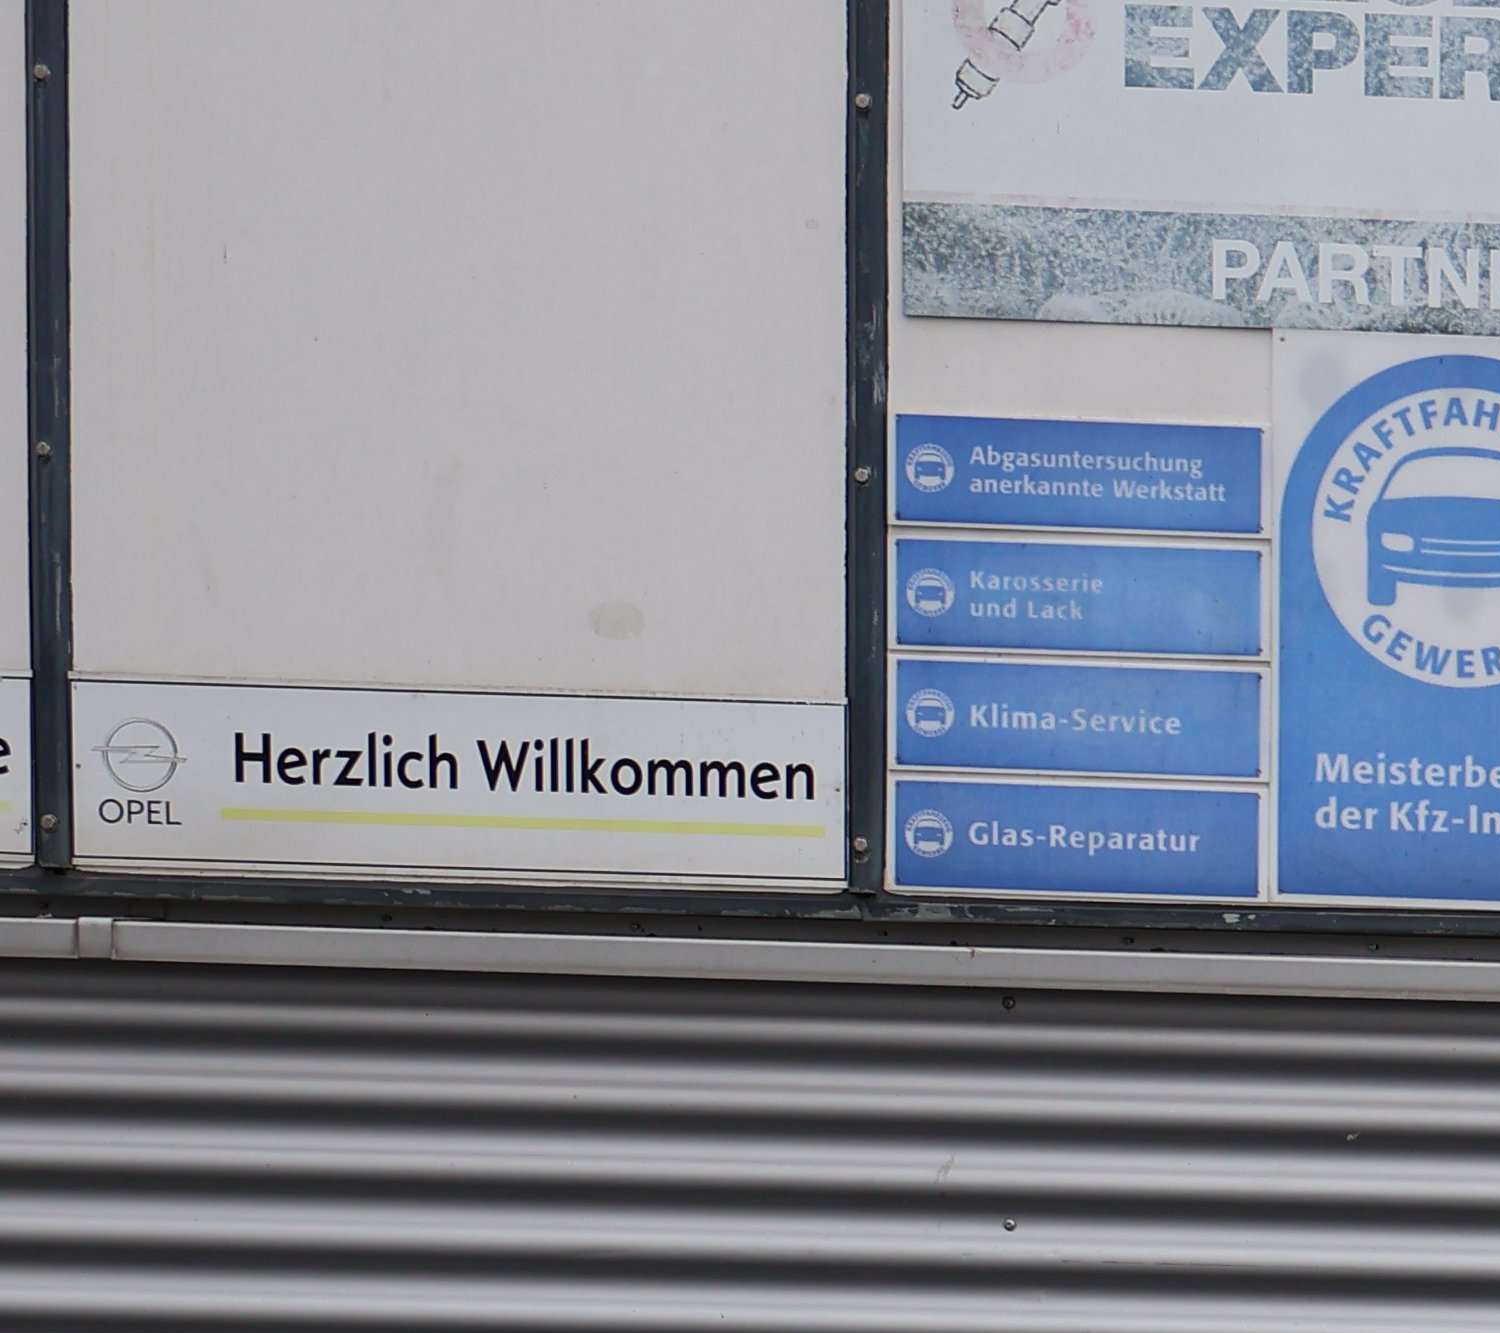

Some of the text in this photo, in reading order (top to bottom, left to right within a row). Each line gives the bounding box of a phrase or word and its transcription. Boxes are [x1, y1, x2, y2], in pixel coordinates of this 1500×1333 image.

[970, 445, 1203, 480] Abgasuntersuchung
[969, 476, 1226, 504] anerkannte Werkstatt
[970, 570, 1104, 596] Karosserie
[969, 600, 1084, 622] und Lack
[970, 702, 1182, 736] Klima-Service
[234, 731, 815, 800] Herzlich Willkommen
[98, 798, 183, 826] OPEL
[1314, 797, 1378, 831] der
[968, 820, 1200, 856] Glas-Reparatur
